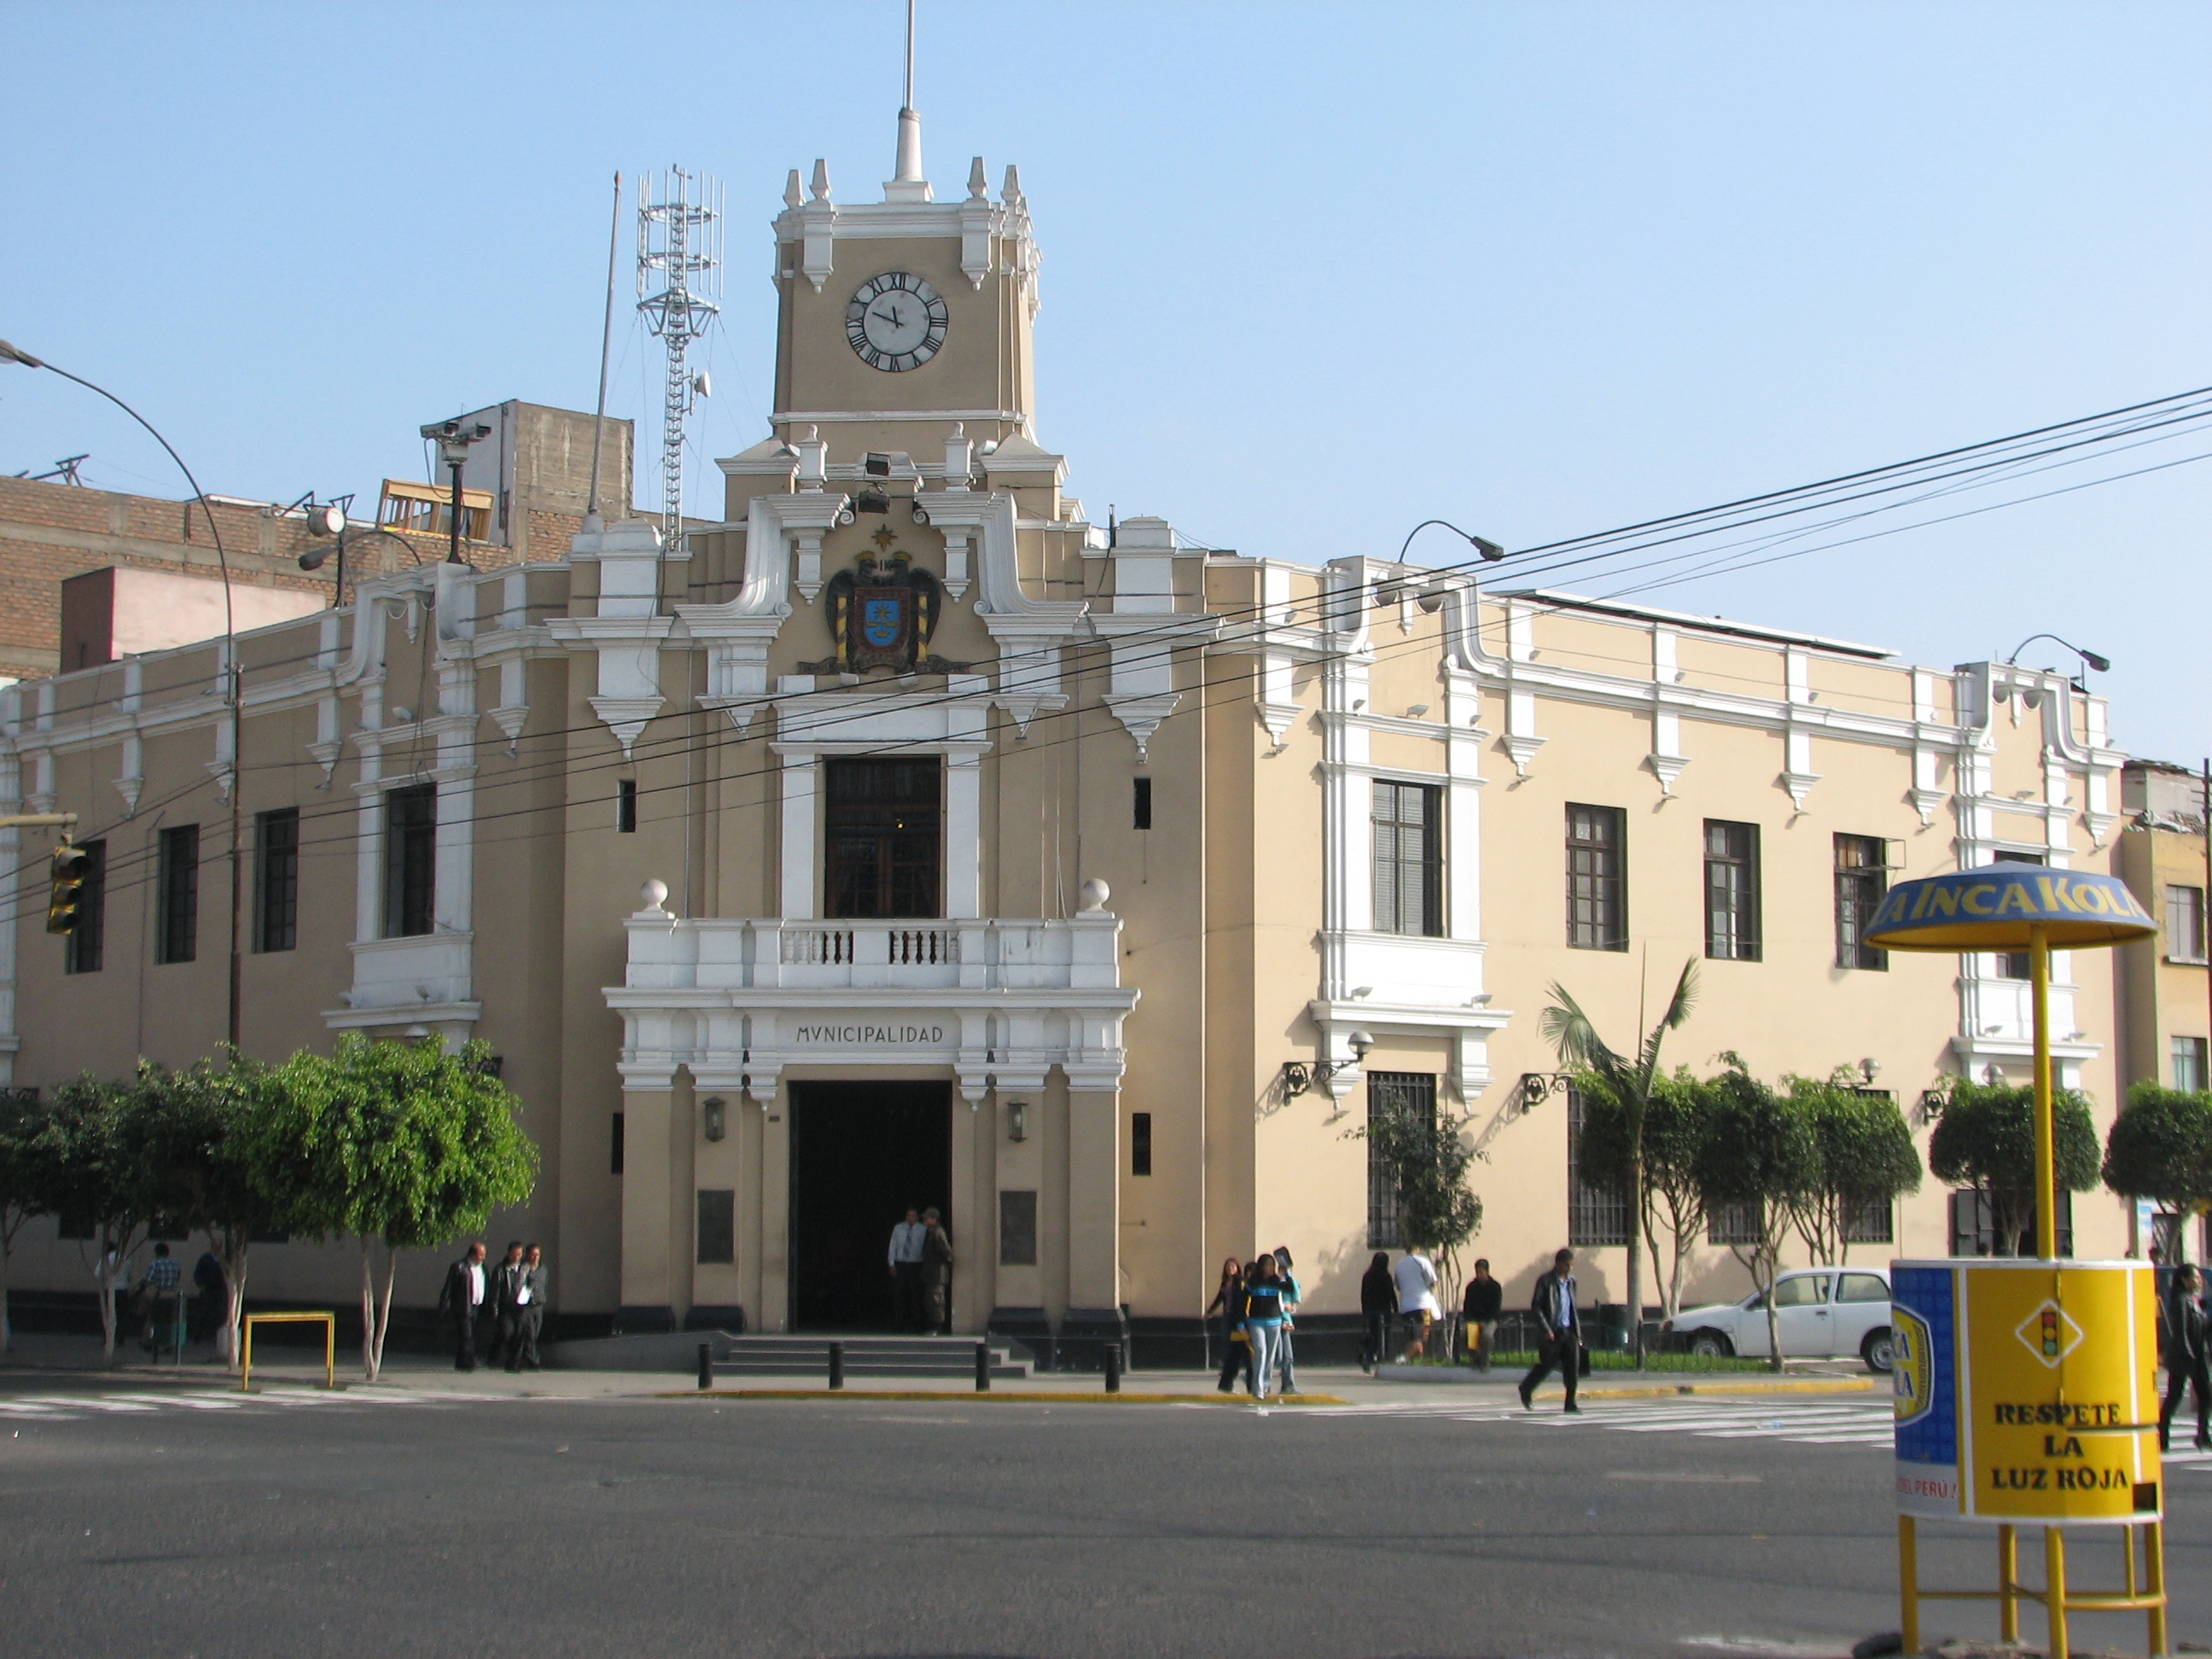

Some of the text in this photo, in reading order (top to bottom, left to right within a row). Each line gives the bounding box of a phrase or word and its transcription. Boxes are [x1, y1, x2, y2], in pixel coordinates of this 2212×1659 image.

[1910, 882, 2038, 919] INCA
[2036, 876, 2151, 920] KOLA
[796, 1026, 943, 1043] MVNICIPALIDAD
[1994, 1403, 2122, 1426] RESPETE
[2045, 1435, 2084, 1458] LA
[1992, 1466, 2129, 1491] LUZ ROJA
